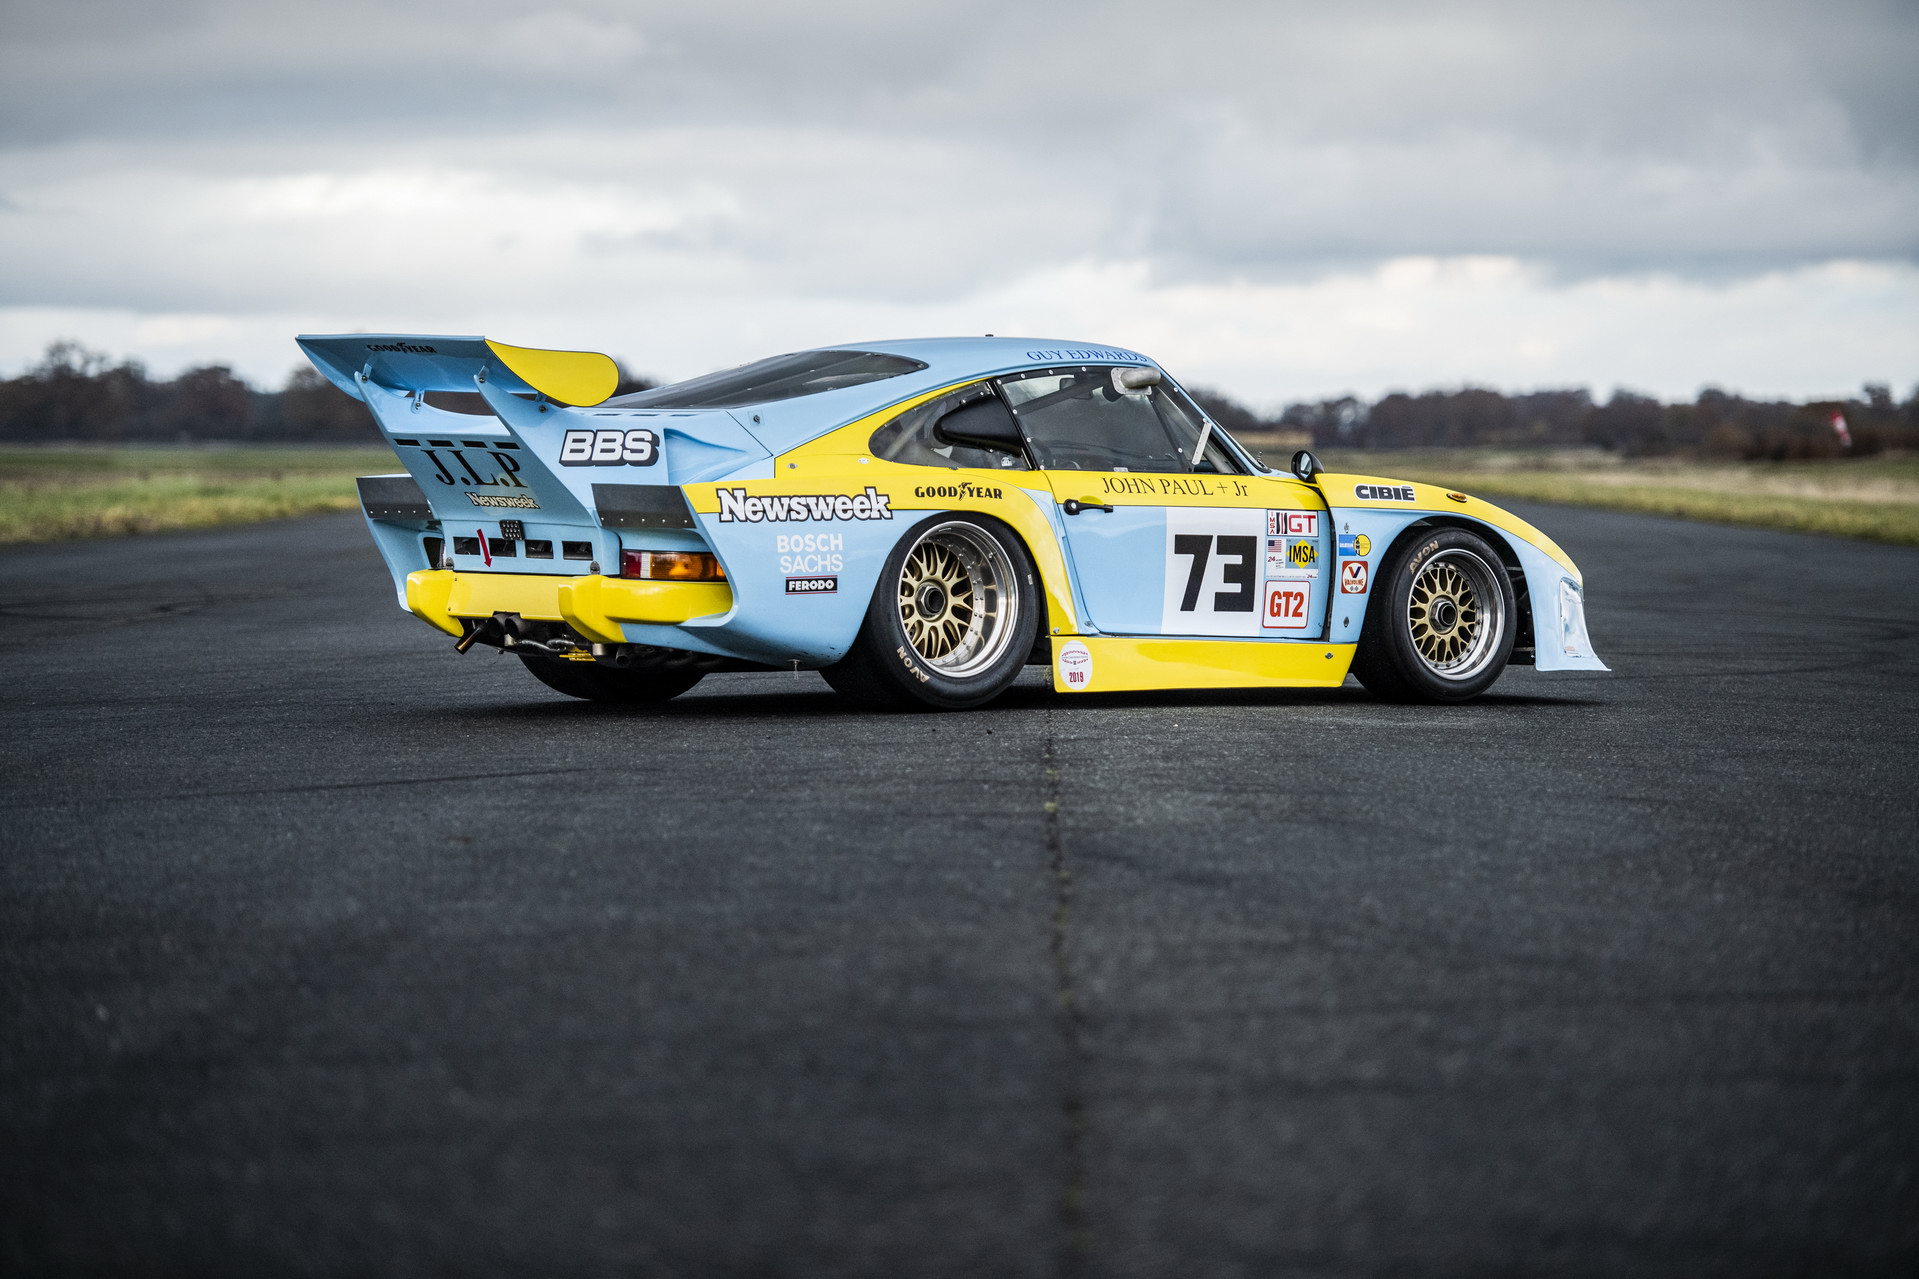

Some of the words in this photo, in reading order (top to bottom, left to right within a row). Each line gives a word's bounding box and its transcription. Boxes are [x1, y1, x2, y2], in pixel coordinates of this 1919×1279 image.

[1027, 350, 1063, 360] GUY
[1066, 350, 1147, 362] EDWARDS
[559, 429, 659, 467] BBS
[1104, 477, 1155, 494] JOHN
[1162, 478, 1214, 496] PAUL
[1217, 482, 1228, 494] +
[1235, 481, 1248, 497] Jr
[464, 492, 540, 509] Newsweek
[716, 486, 893, 522] Newsweek
[1288, 514, 1316, 533] GT
[776, 533, 843, 553] BOSCH
[779, 554, 844, 574] SACHS
[1288, 545, 1316, 563] IMSA
[1410, 540, 1439, 575] AVON
[1174, 534, 1257, 612] 73
[788, 580, 834, 591] FERODO
[1269, 591, 1305, 618] GT2
[896, 645, 930, 683] AVON
[1069, 671, 1084, 683] 2019
